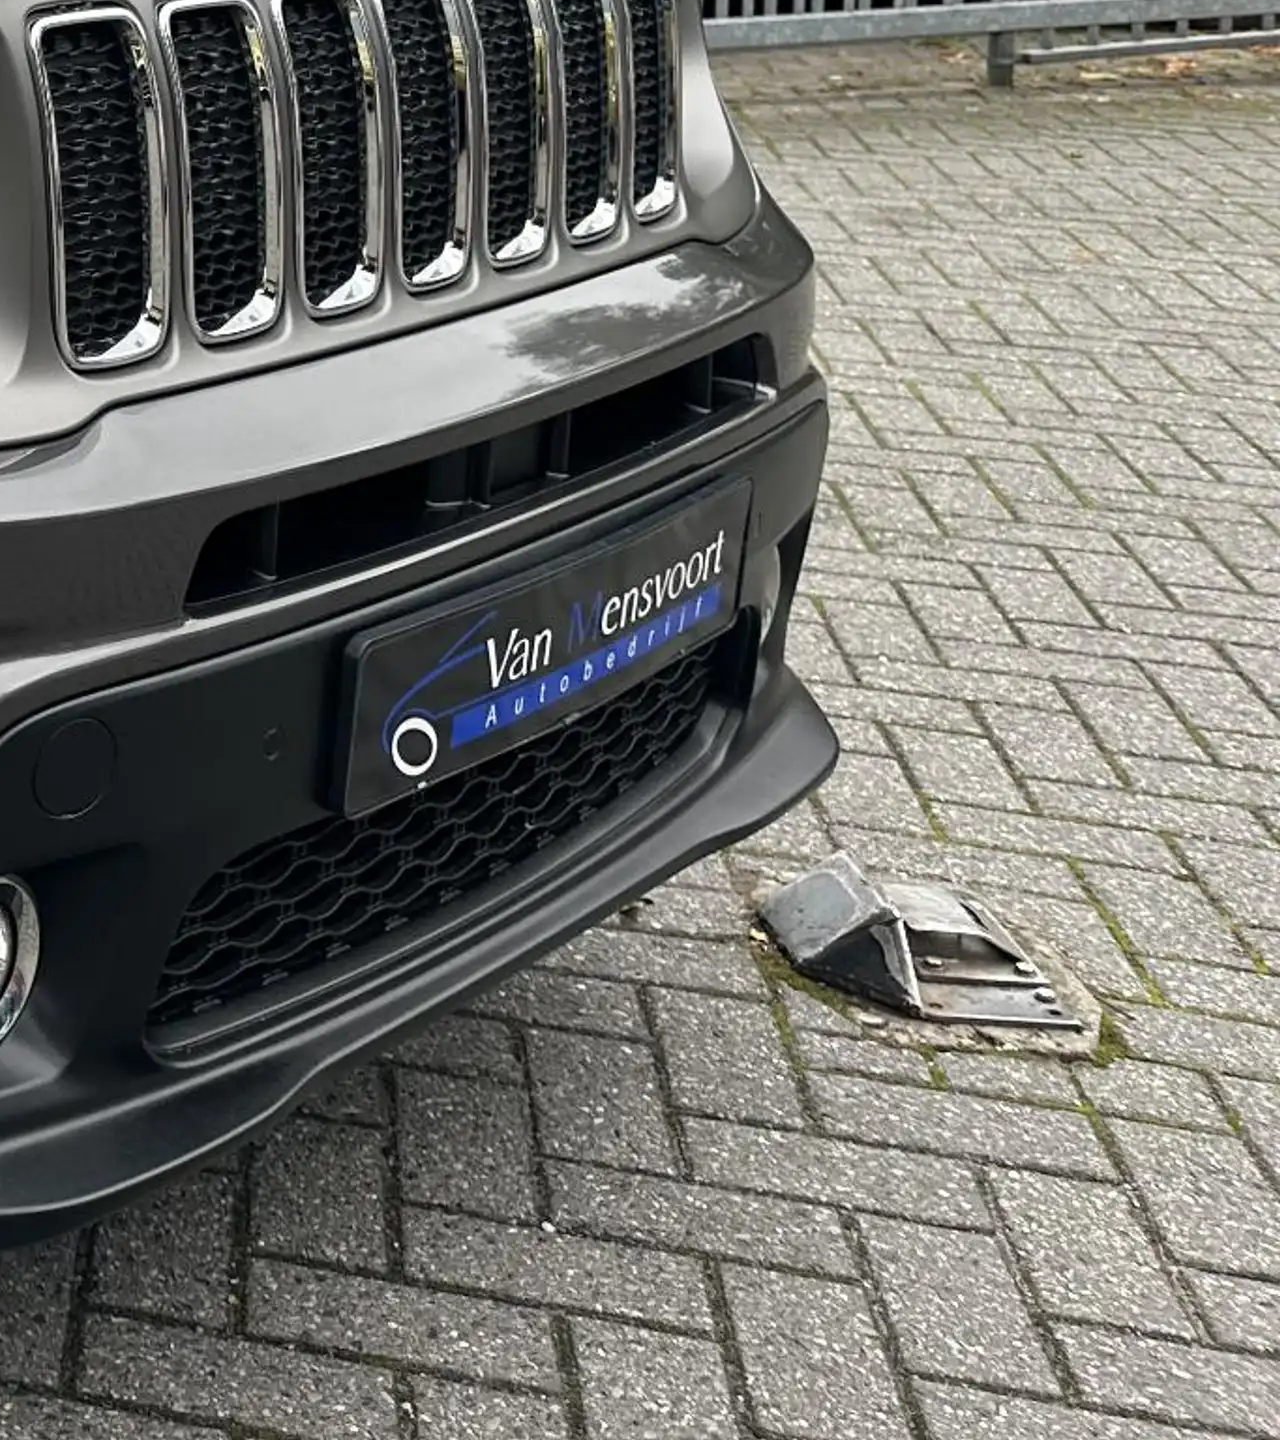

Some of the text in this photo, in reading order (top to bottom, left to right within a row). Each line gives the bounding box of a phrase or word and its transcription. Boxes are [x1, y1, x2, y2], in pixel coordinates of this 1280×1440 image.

[485, 594, 705, 729] Autobedrijf
[487, 529, 725, 689] Van Mensvoort
